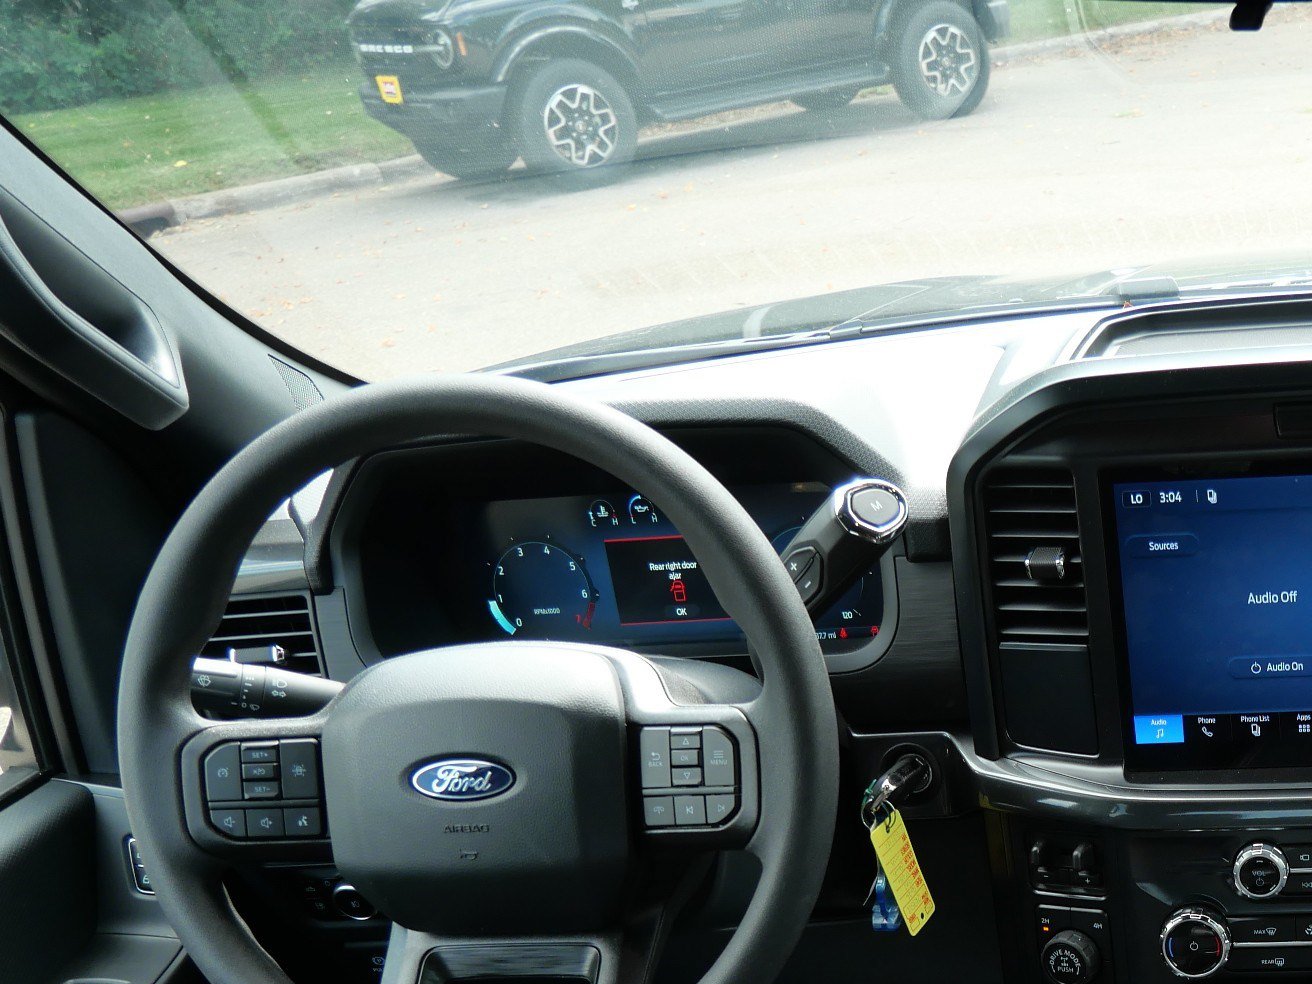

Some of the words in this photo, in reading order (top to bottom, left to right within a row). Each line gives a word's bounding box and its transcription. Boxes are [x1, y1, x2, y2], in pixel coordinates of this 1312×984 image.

[1130, 494, 1143, 504] LO
[1159, 491, 1182, 504] 3:04
[870, 500, 883, 512] M
[612, 517, 619, 526] H
[543, 545, 550, 555] 4
[1149, 541, 1179, 551] Sources
[517, 547, 524, 557] 3
[498, 566, 505, 576] 2
[569, 561, 576, 571] 5
[649, 562, 665, 571] Rear
[665, 561, 682, 572] right
[681, 560, 697, 569] door
[669, 571, 682, 580] ajar
[498, 594, 503, 604] 1
[581, 589, 588, 599] 6
[1247, 592, 1279, 605] Audio
[1280, 590, 1298, 603] Off
[676, 607, 688, 616] OK
[841, 611, 853, 620] 120
[516, 617, 523, 627] 0
[1266, 662, 1291, 672] Audio
[1291, 661, 1304, 671] On
[1240, 715, 1259, 723] Phone
[1259, 714, 1270, 722] List
[1296, 713, 1311, 721] Apps
[431, 765, 493, 793] Ford
[444, 824, 490, 834] AIRBAG
[1049, 949, 1063, 966] DRIVE
[1064, 949, 1082, 968] MODE
